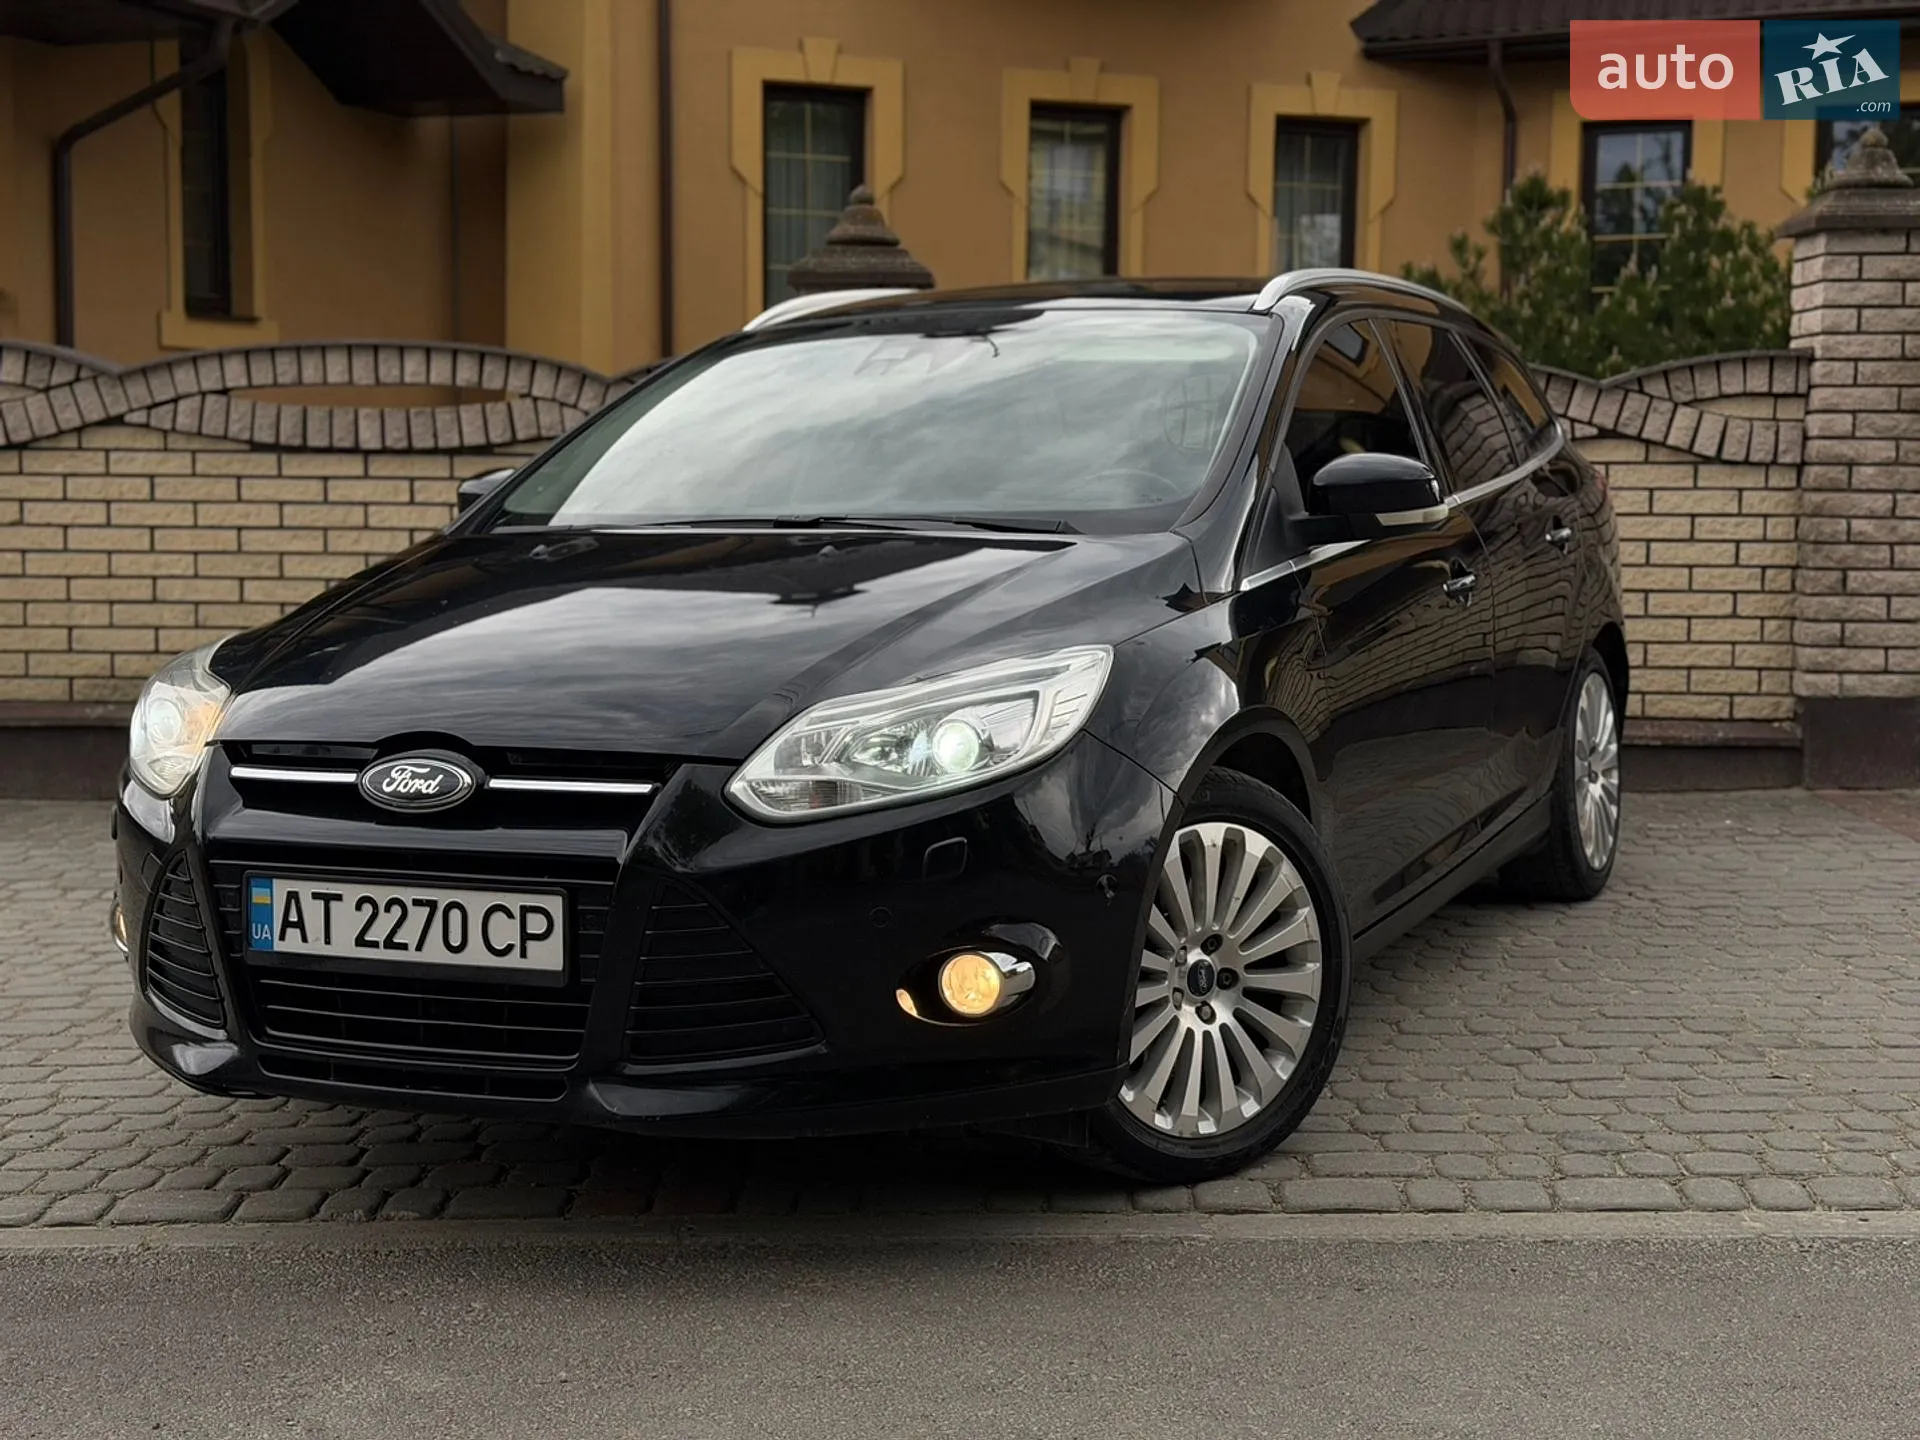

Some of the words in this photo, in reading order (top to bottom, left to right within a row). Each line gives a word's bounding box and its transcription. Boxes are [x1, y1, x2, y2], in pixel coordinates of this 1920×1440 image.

[382, 765, 444, 794] Ford
[251, 923, 272, 940] UA
[278, 889, 343, 945] AT
[354, 894, 468, 954] 2270
[481, 903, 555, 959] CP
